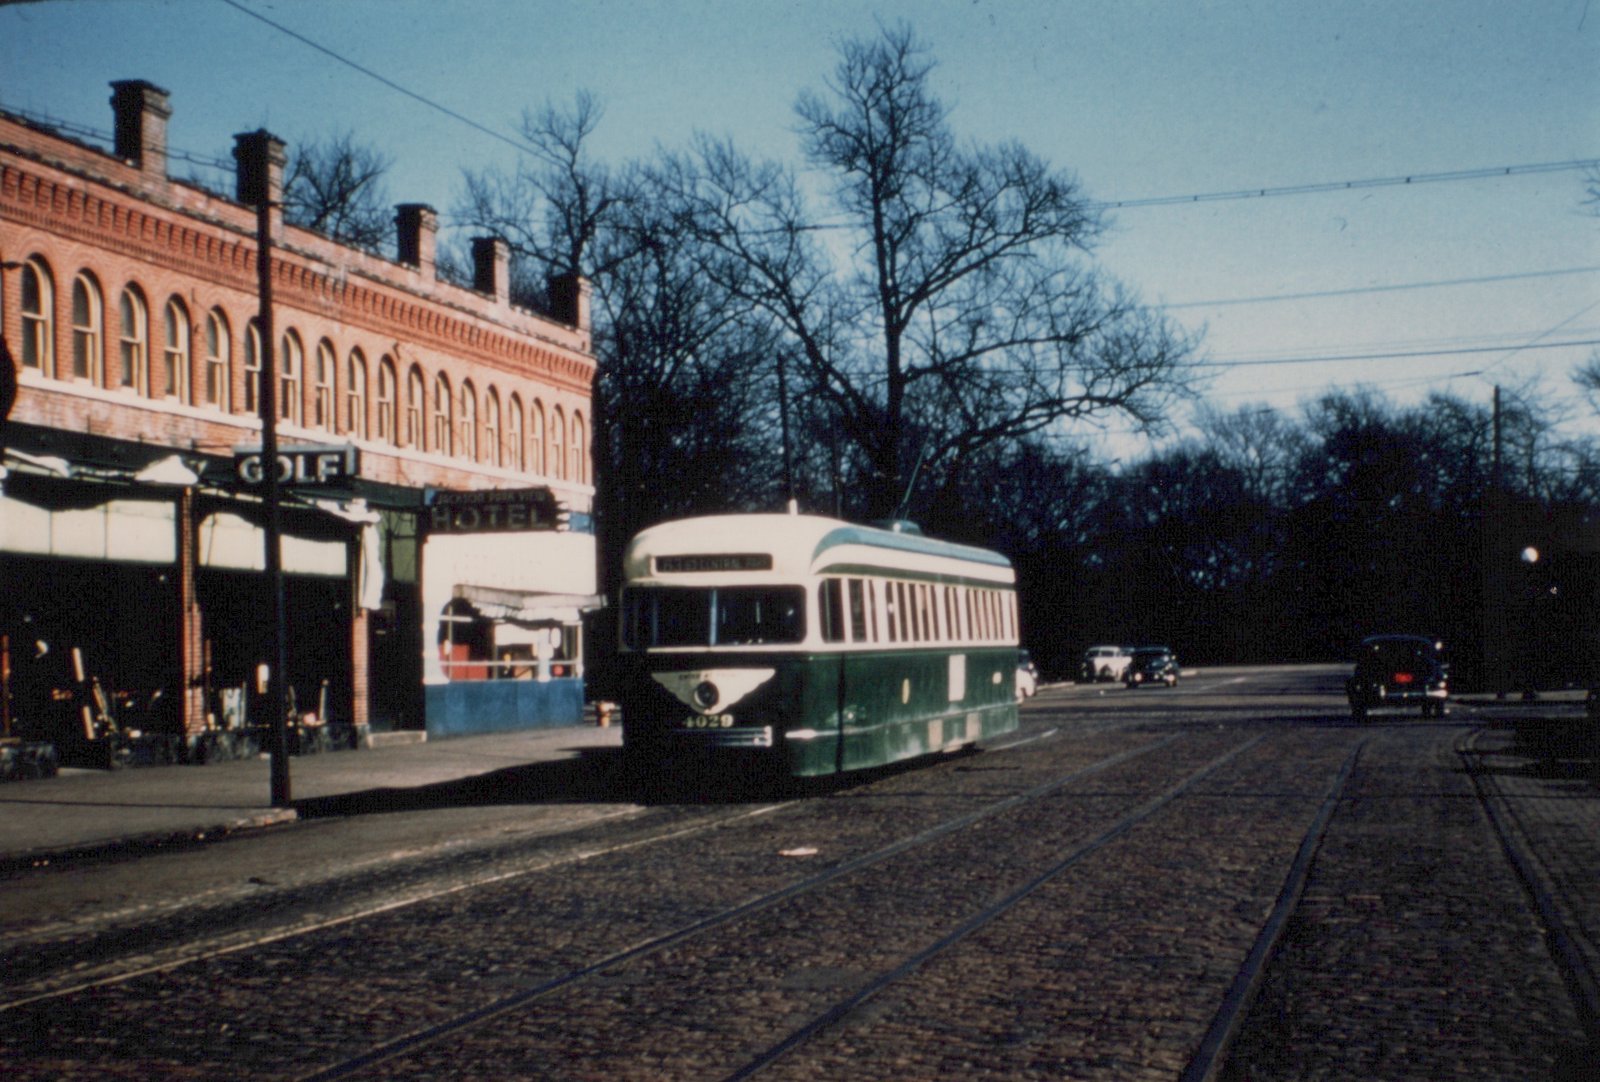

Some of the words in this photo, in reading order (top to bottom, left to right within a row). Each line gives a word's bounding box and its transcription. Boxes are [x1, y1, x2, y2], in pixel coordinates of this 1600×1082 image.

[239, 454, 340, 482] GOLF
[432, 504, 549, 530] HOTEL
[682, 714, 734, 728] 4029
